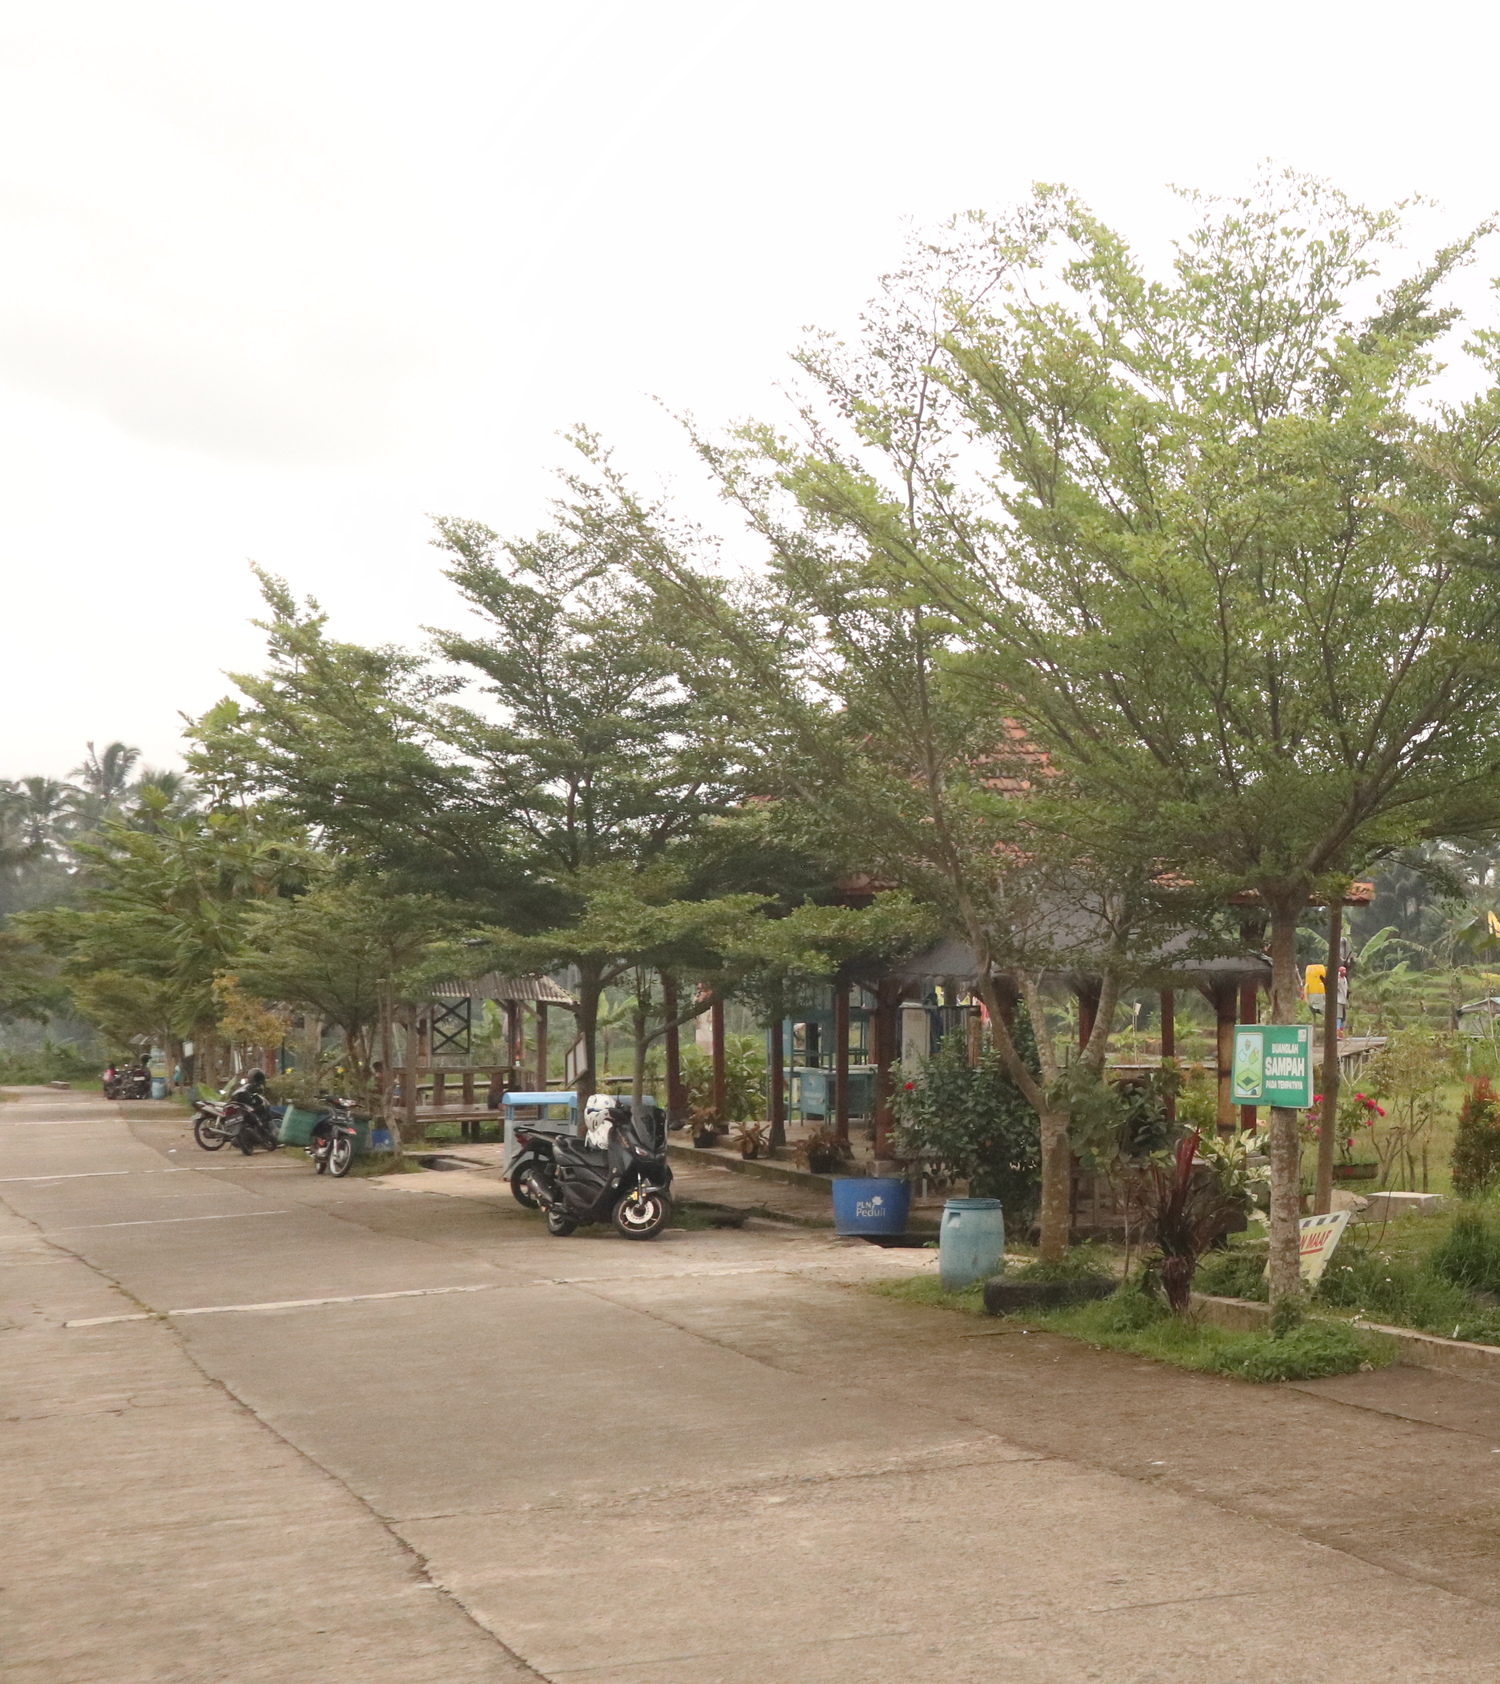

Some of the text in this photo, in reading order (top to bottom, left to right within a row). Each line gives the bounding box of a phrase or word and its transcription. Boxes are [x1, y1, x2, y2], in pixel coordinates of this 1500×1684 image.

[1271, 1043, 1299, 1054] BUANGLAH
[1265, 1056, 1305, 1077] SAMPAH
[1265, 1080, 1303, 1090] PADA TEMPATNYA
[856, 1201, 871, 1209] PLN
[856, 1207, 886, 1217] Peduli
